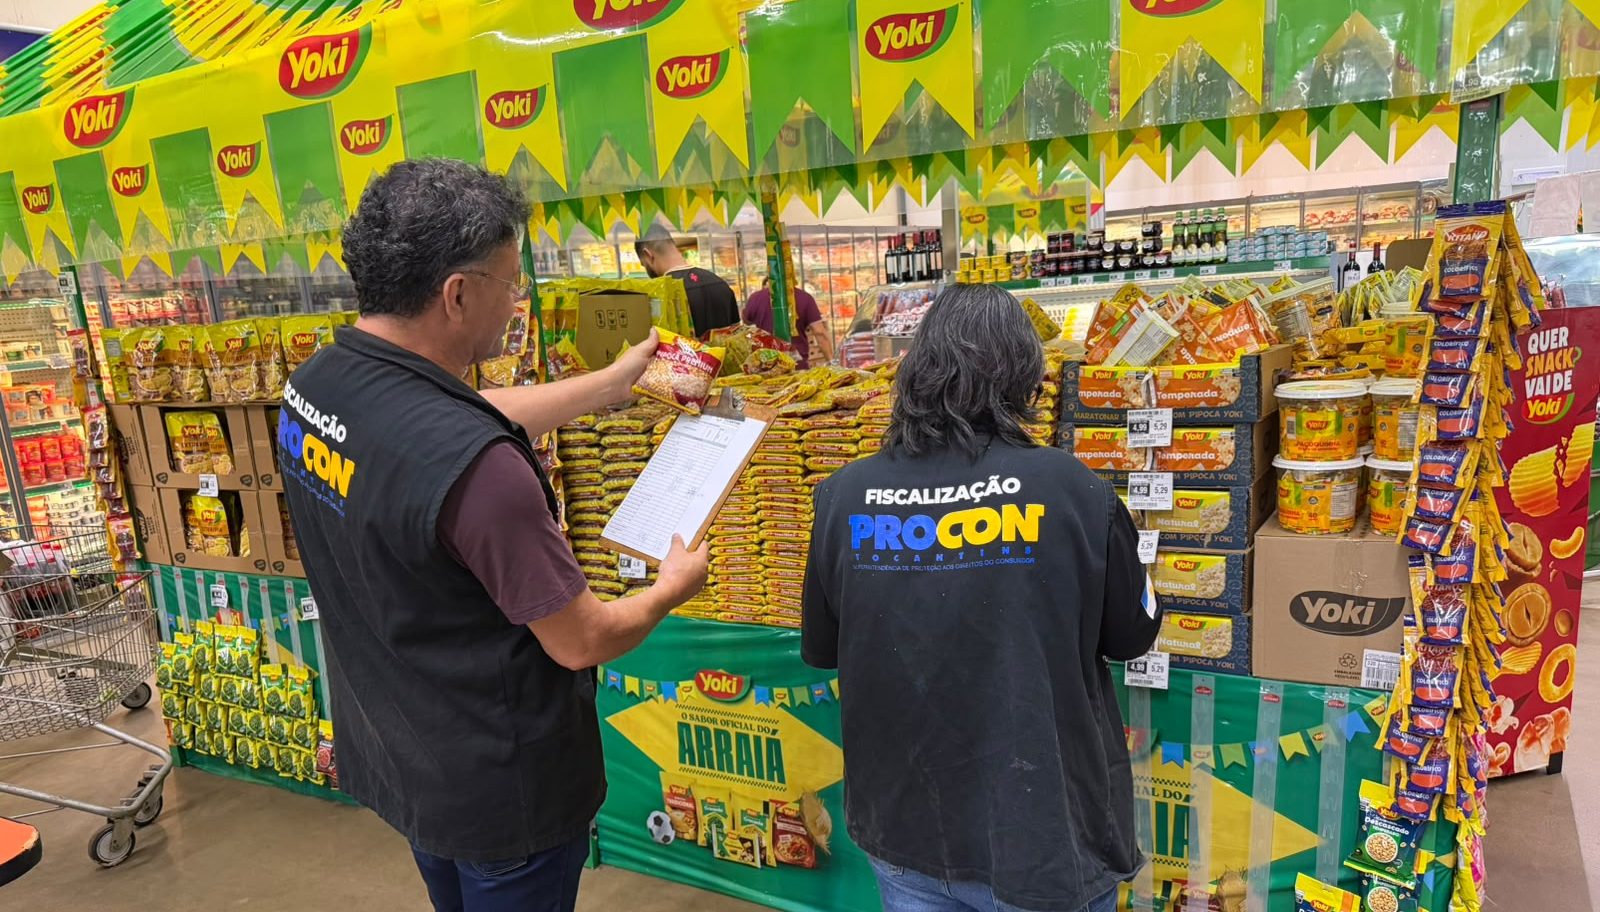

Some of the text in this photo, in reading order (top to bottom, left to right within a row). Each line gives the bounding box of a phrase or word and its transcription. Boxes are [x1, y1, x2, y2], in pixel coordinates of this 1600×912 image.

[874, 16, 935, 54] Yoki
[287, 38, 349, 88] Yoki
[661, 58, 712, 92] Yoki
[71, 98, 118, 139] Yoki
[490, 93, 531, 123] Yoki
[344, 122, 380, 146] Yoki
[220, 147, 251, 170] Yoki
[115, 169, 142, 191] Yoki
[24, 187, 48, 208] Yoki
[295, 334, 315, 345] Yoki
[1527, 326, 1568, 354] QUER
[1095, 371, 1112, 379] Yoki
[1186, 371, 1205, 380] Yoki
[1525, 370, 1573, 399] VAI DE
[1078, 390, 1122, 399] mperada
[1156, 390, 1218, 401] Temperada
[1527, 397, 1562, 419] Yoki
[183, 426, 204, 435] Yoki
[1185, 432, 1204, 441] Yoki
[277, 406, 355, 498] ROCON
[1074, 450, 1123, 459] emperada
[865, 474, 1021, 504] FISCALIZAÇÃO
[1177, 499, 1197, 507] Yoki
[848, 504, 1045, 550] PROCON
[1175, 561, 1195, 569] Yoki
[1177, 598, 1207, 606] PIPOCA
[1210, 601, 1229, 609] YOKI
[1301, 596, 1376, 625] Yoki
[1181, 620, 1201, 628] Yoki
[1183, 658, 1214, 666] PIPOCA
[699, 672, 738, 694] Yoki
[681, 712, 770, 734] O SABOR OFICIAL DO
[677, 721, 786, 785] ARRAIÁ
[1163, 789, 1183, 800] DO
[1380, 807, 1397, 817] Yoki
[1365, 816, 1409, 835] Descascado
[1313, 901, 1329, 911] Yoki
